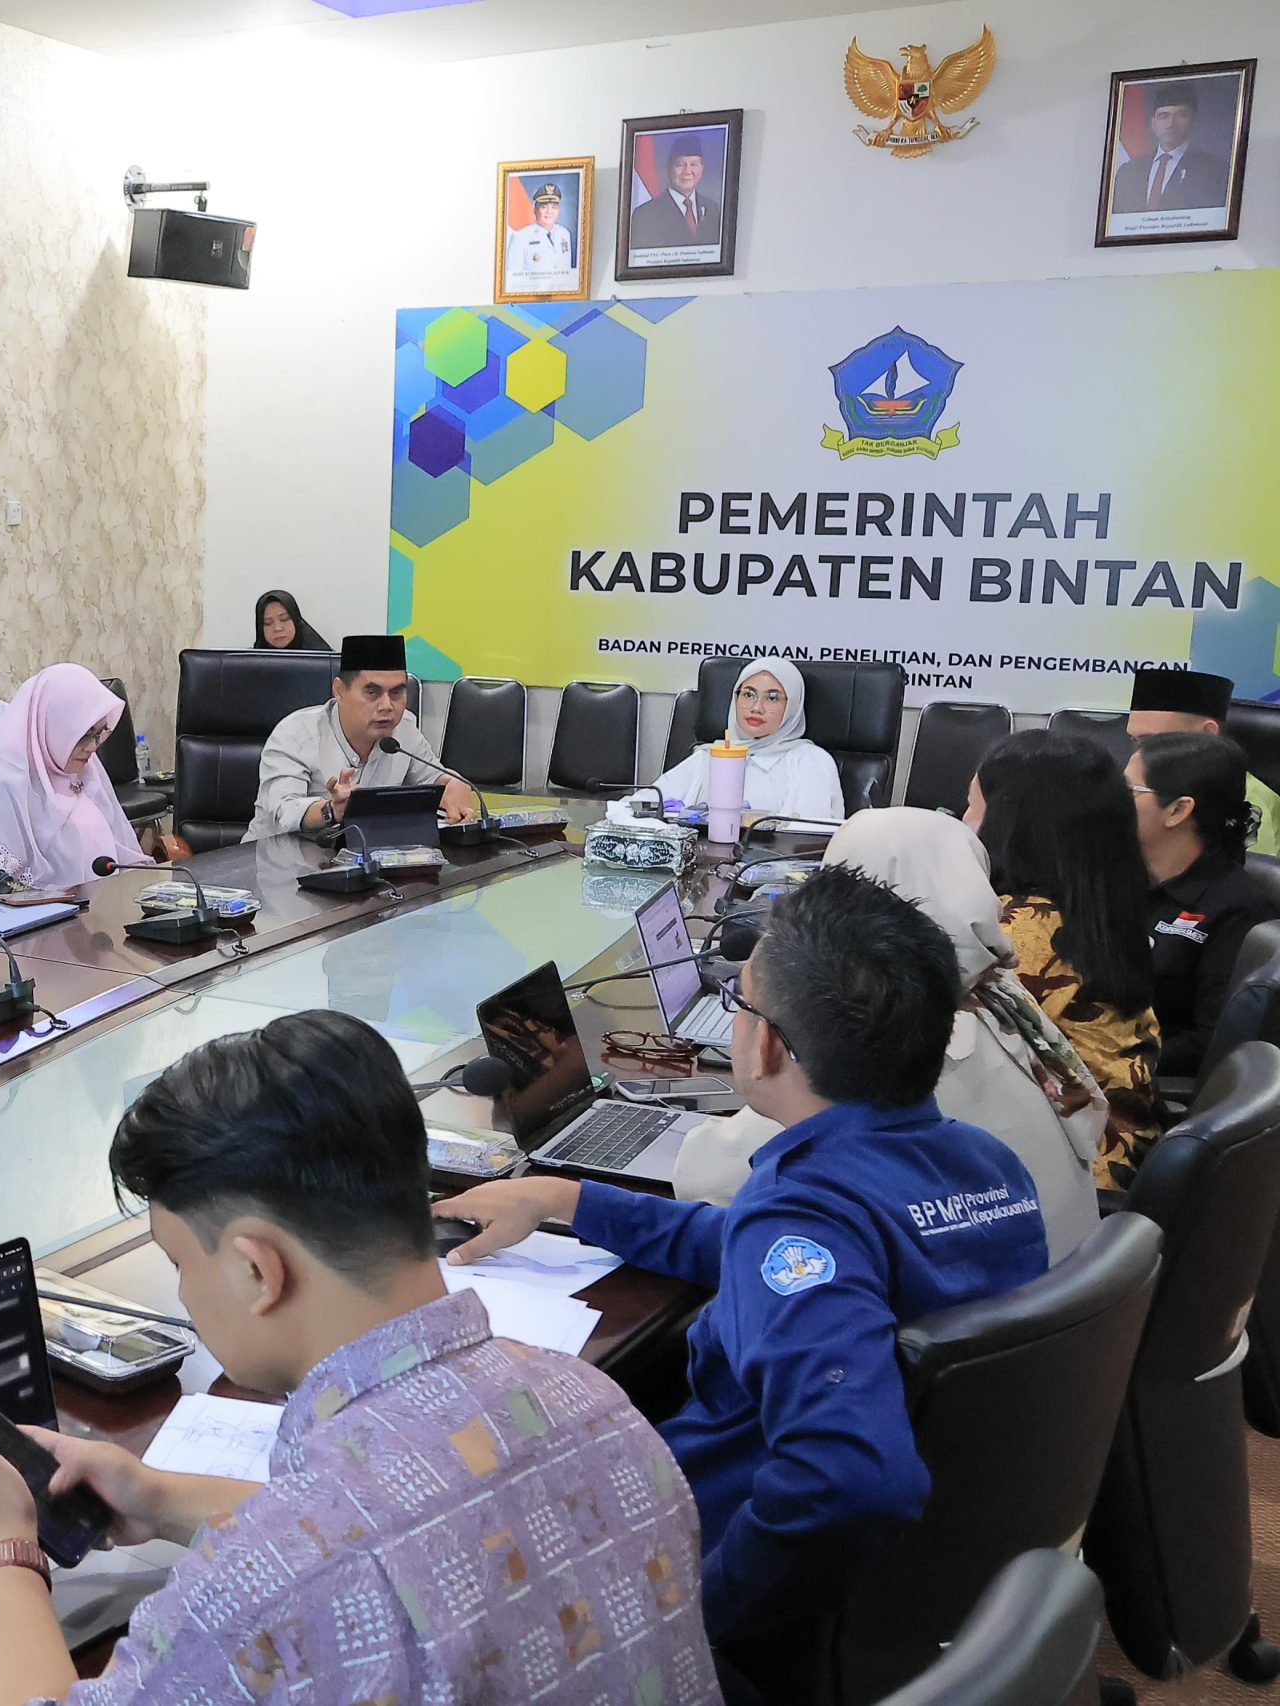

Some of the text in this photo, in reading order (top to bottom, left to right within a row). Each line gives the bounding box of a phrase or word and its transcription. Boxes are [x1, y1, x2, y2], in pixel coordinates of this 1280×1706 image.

[678, 491, 1111, 541] PEMERINTAH
[570, 550, 1243, 610] KABUPATEN BINTAN
[598, 638, 662, 654] BADAN
[667, 641, 814, 661] PERENCANAAN,
[819, 647, 942, 668] PENELITIAN,
[948, 652, 993, 668] DAN
[964, 1182, 1010, 1208] Provinsi
